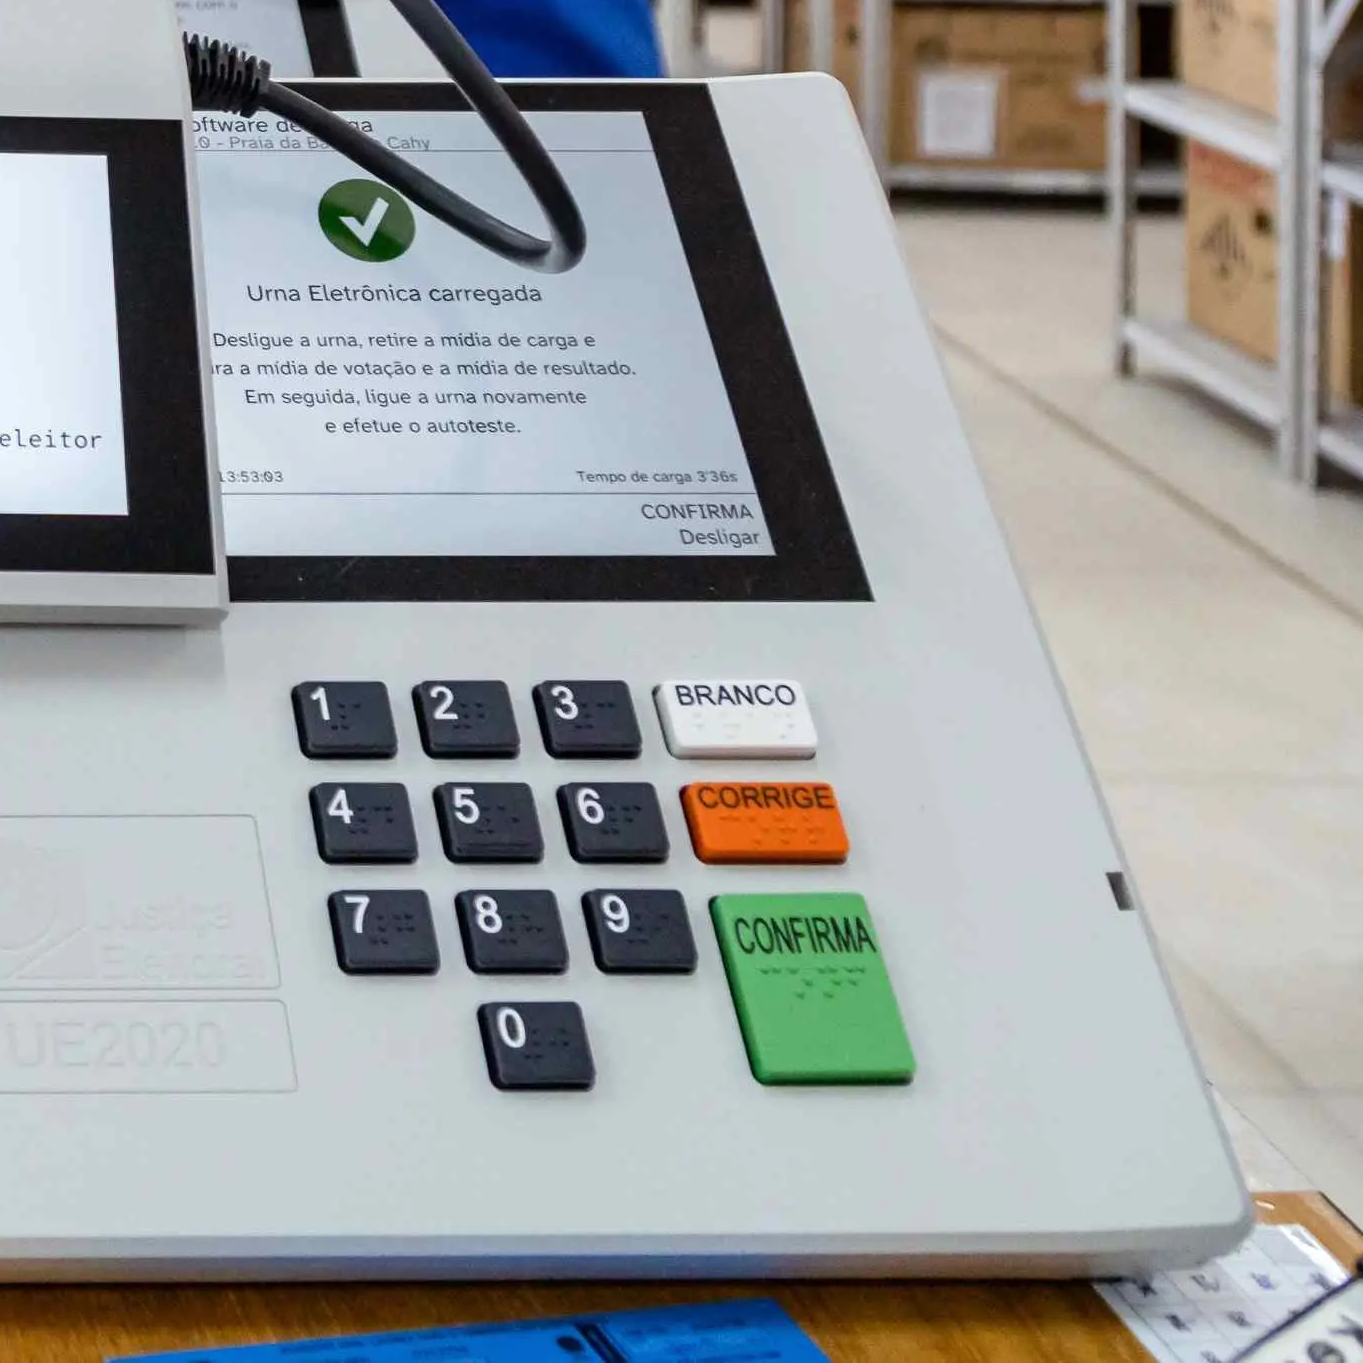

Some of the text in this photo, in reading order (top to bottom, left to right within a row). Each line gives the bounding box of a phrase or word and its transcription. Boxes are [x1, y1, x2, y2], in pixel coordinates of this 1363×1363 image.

[192, 116, 269, 134] oftware
[230, 136, 274, 150] Praia
[279, 136, 301, 150] da
[387, 136, 430, 153] Cahy
[247, 284, 543, 306] Urna Eletrônica carregada
[213, 332, 293, 350] Desligue
[300, 336, 311, 347] a
[317, 336, 363, 350] urna,
[368, 332, 418, 347] retire
[424, 336, 435, 347] a
[498, 332, 521, 347] de
[527, 336, 579, 350] carga
[584, 336, 596, 347] e
[212, 363, 234, 375] ra
[240, 364, 251, 375] a
[315, 360, 338, 375] de
[344, 360, 416, 379] votação
[422, 364, 433, 375] e
[440, 364, 451, 375] a
[514, 360, 537, 375] de
[544, 360, 636, 376] resultado.
[245, 389, 587, 407] Em seguida, ligue a urna novamente
[325, 417, 522, 433] e efetue o autoteste.
[0, 428, 102, 449] eleitor
[576, 470, 738, 486] Tempo de carga 3'36s
[641, 503, 754, 520] CONFIRMA
[679, 528, 760, 548] Desligar
[310, 686, 331, 721] 1
[430, 685, 459, 720] 2
[550, 685, 579, 720] 3
[675, 684, 797, 706] BRANCO
[327, 788, 354, 824] 4
[452, 788, 480, 824] 5
[576, 787, 605, 825] 6
[697, 786, 836, 809] CORRIGE
[344, 895, 370, 934] 7
[474, 895, 503, 934] 8
[600, 895, 630, 934] 9
[734, 916, 876, 954] CONFIRMA
[497, 1007, 526, 1048] 0
[6, 1019, 228, 1068] UE2020
